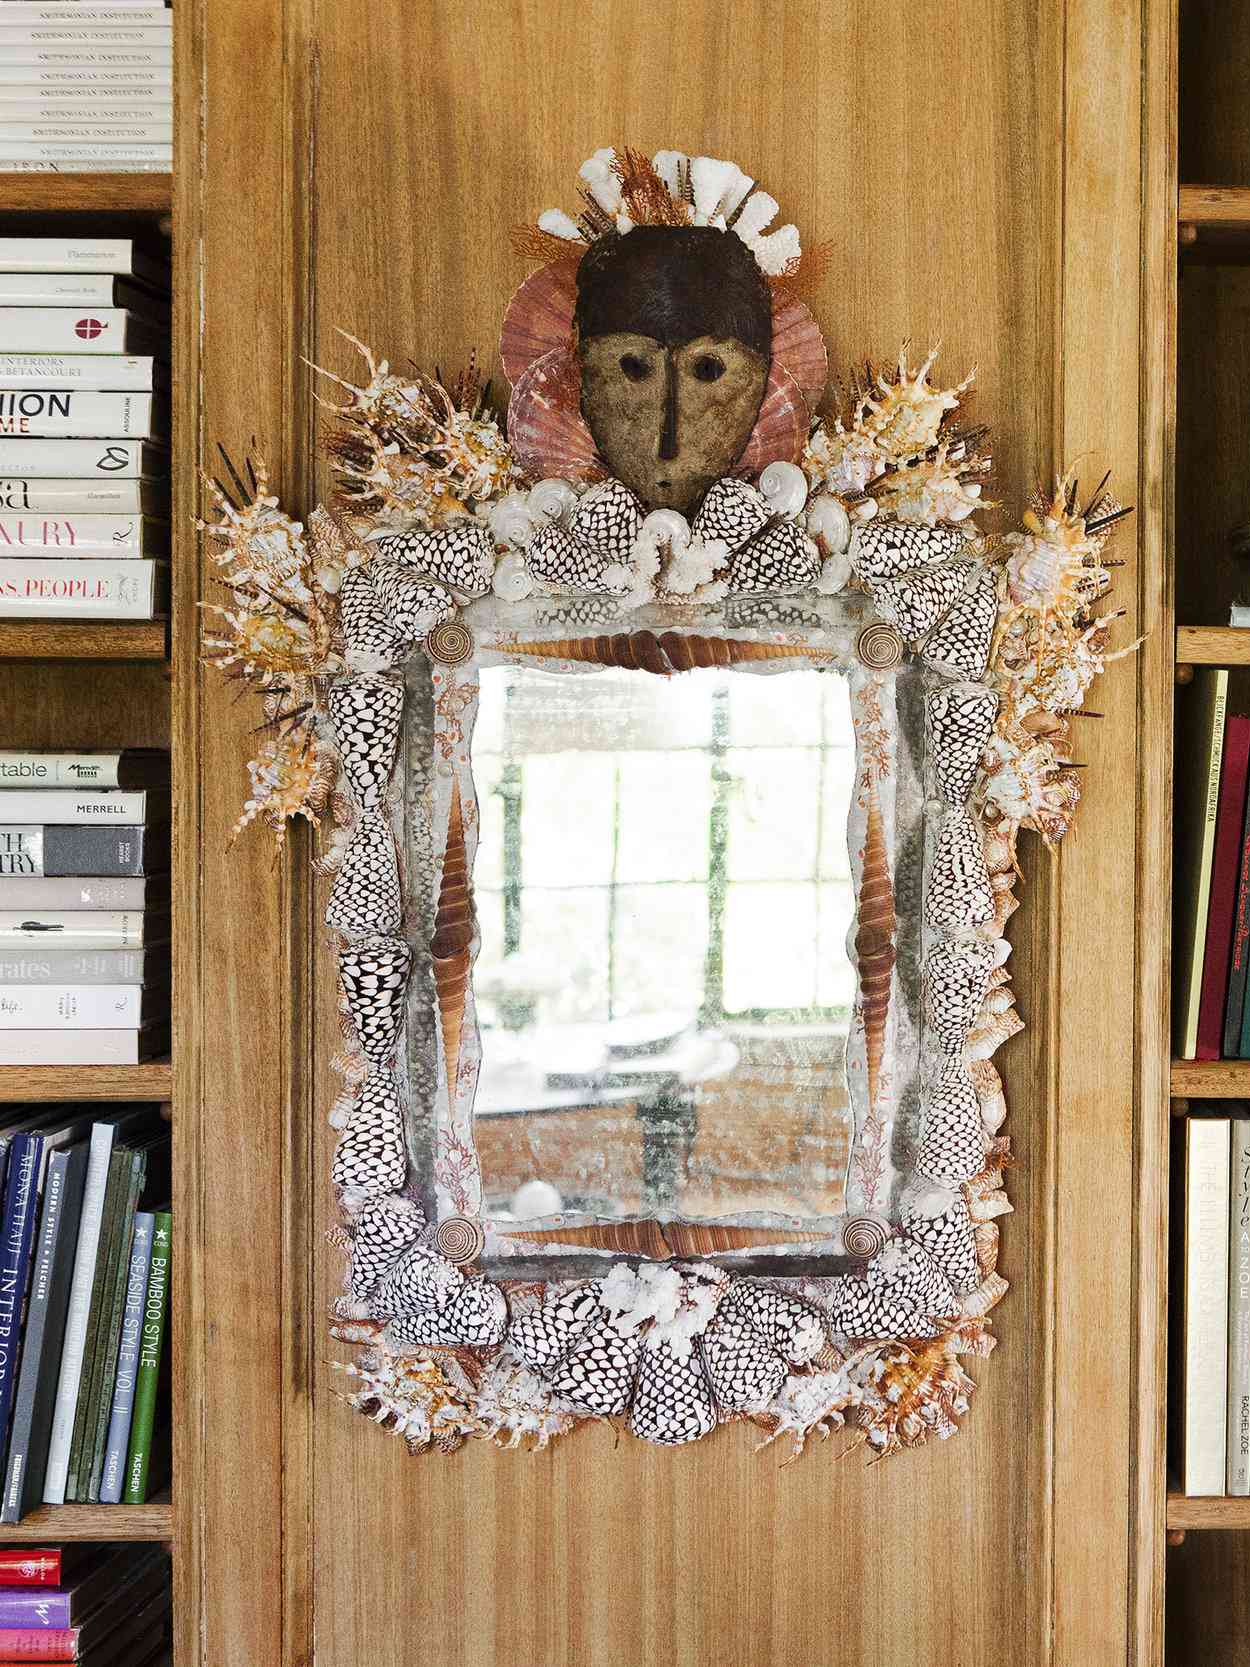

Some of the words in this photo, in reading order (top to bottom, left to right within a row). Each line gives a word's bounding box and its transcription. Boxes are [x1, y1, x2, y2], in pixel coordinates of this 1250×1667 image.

[76, 804, 126, 814] MERRELL
[124, 1256, 146, 1316] SEASIDE
[145, 1257, 167, 1321] BAMBOO
[119, 1319, 140, 1362] STYLE
[140, 1324, 161, 1368] STYLE
[1240, 1395, 1250, 1433] RACHEL
[1240, 1435, 1249, 1456] ZOE
[105, 1450, 120, 1491] TASCHEN
[130, 1453, 144, 1493] TASCHEN
